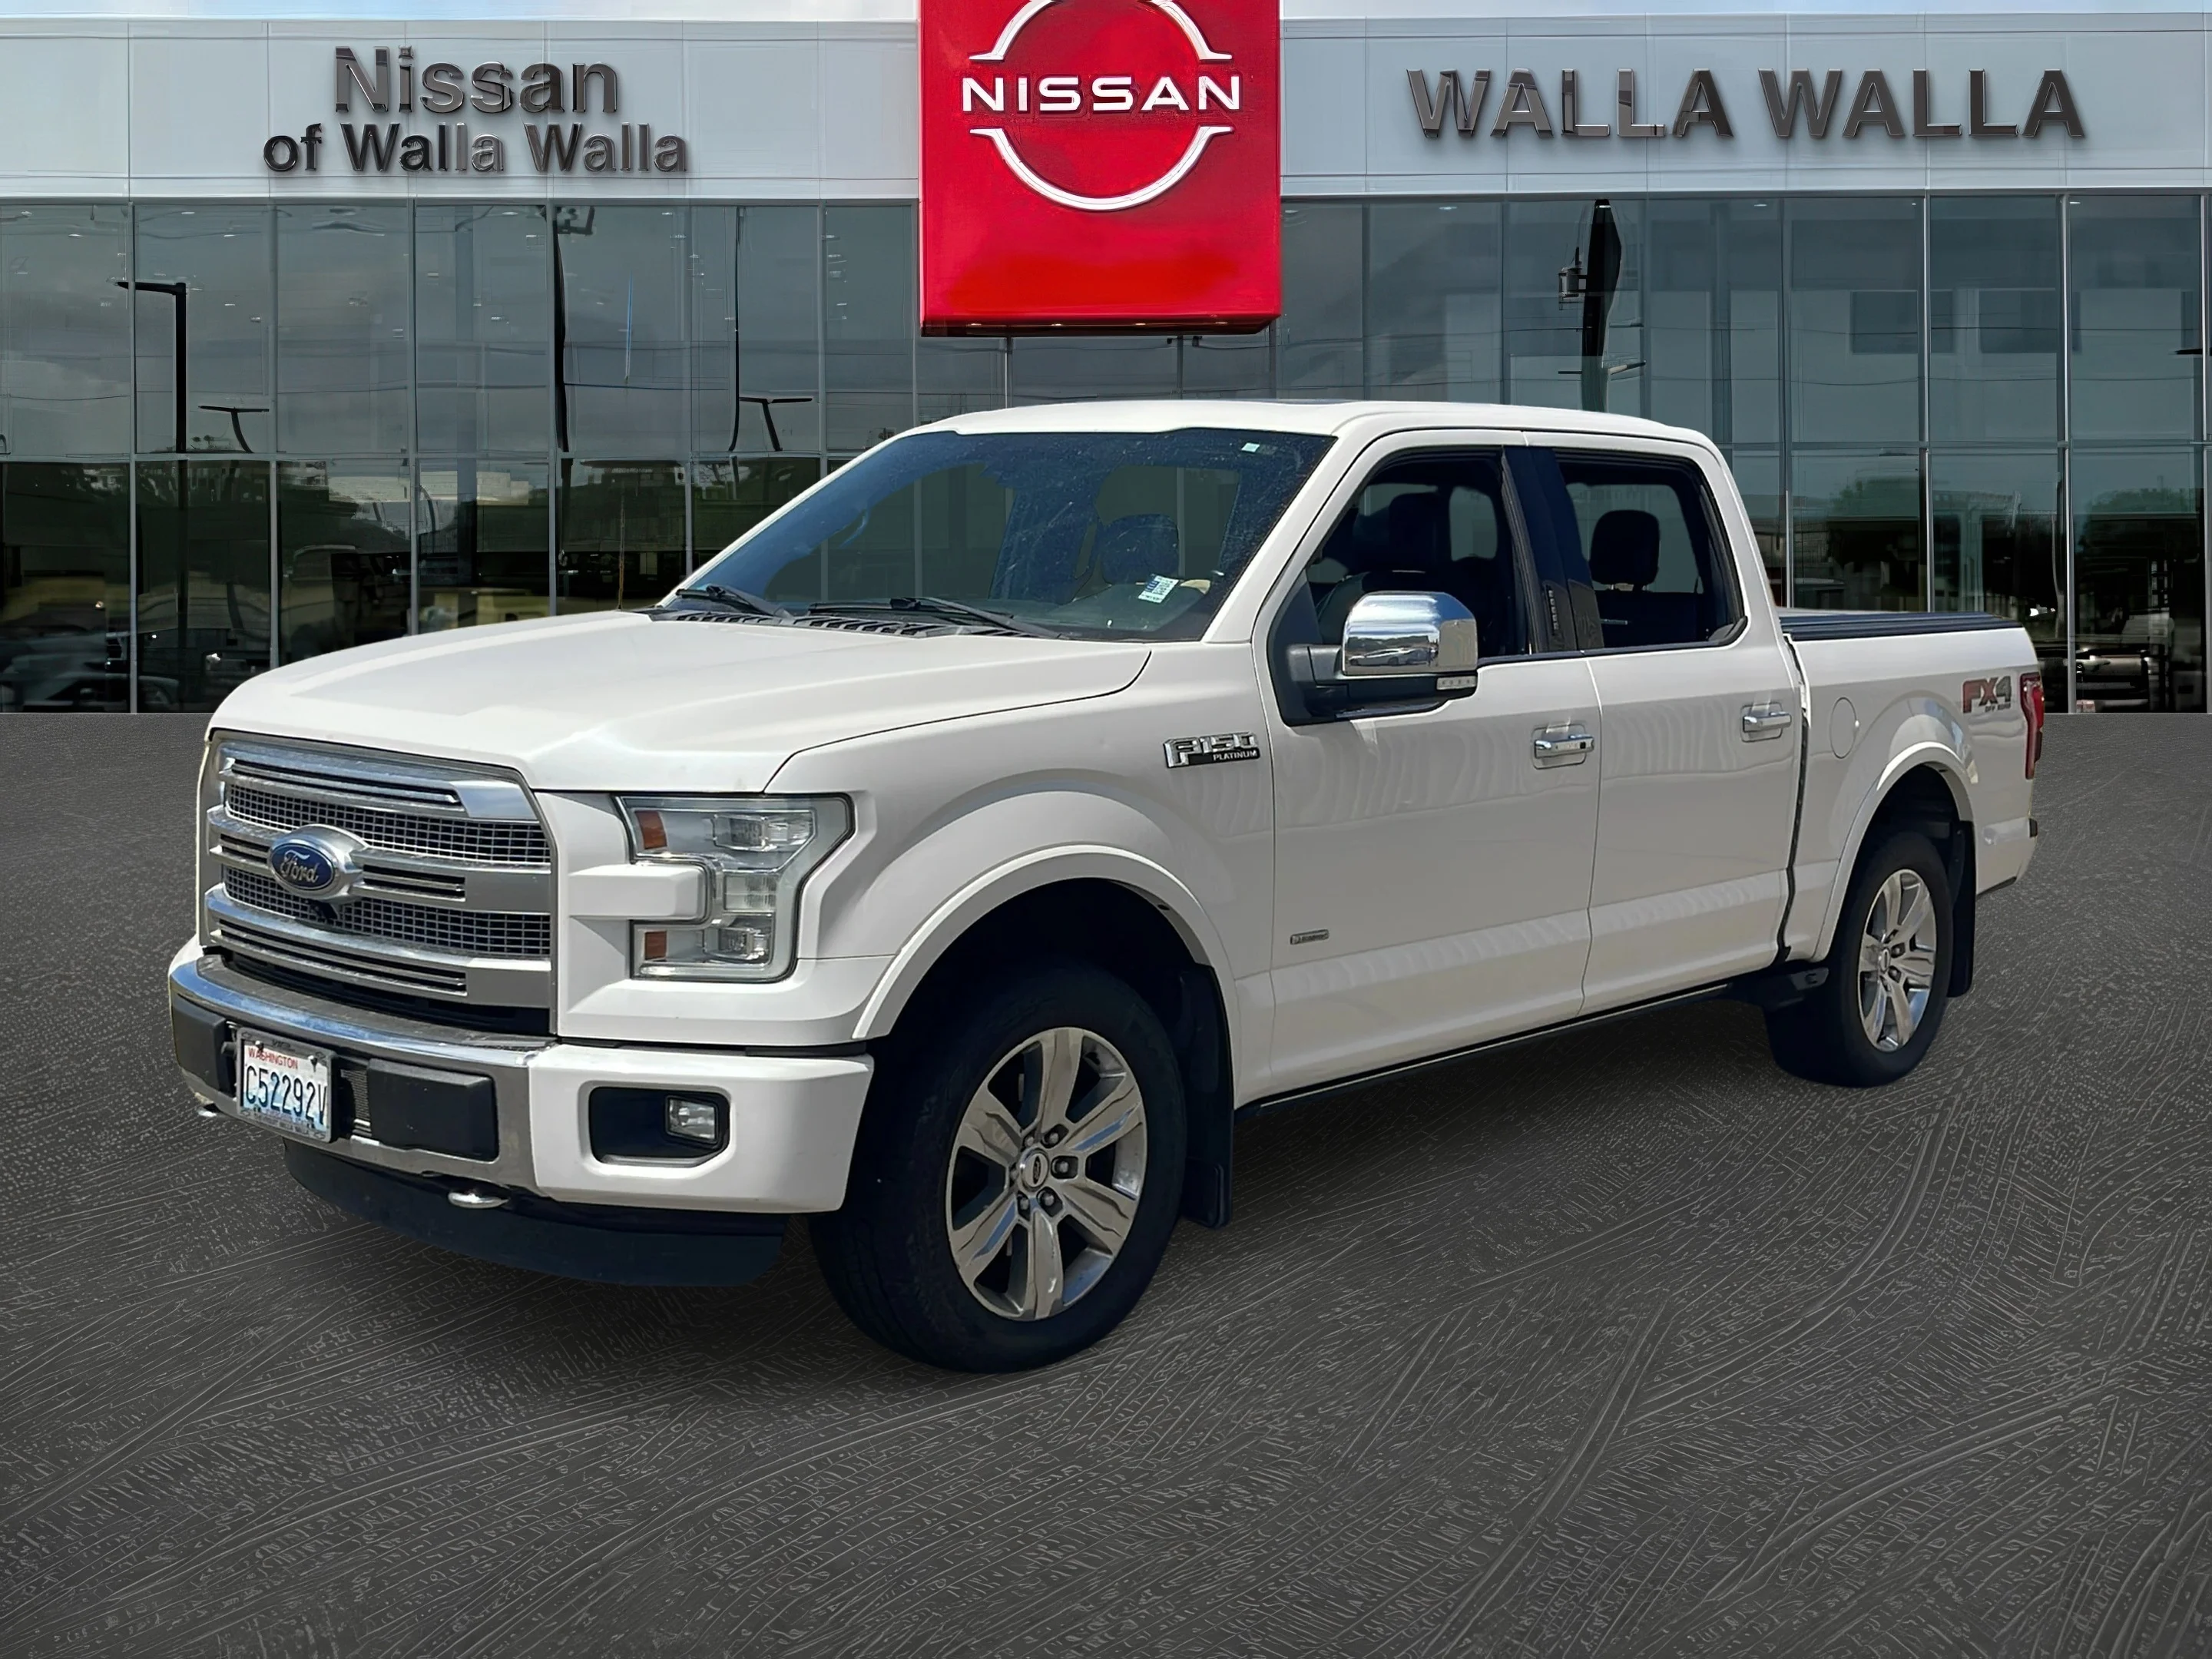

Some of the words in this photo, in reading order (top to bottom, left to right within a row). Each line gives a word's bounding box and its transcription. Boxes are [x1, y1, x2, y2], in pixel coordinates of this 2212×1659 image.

[334, 45, 619, 114] Nissan
[962, 75, 1240, 112] NISSAN
[1406, 67, 1734, 138] WALLA
[1757, 67, 2085, 138] WALLA
[263, 122, 323, 171] of
[339, 121, 505, 172] Walla
[522, 121, 687, 172] Walla
[1962, 675, 2012, 714] FX4
[1213, 750, 1258, 761] PLATINUM
[280, 849, 319, 882] Ford
[248, 1047, 298, 1069] WASHINGTON
[246, 1065, 328, 1125] C52292V
